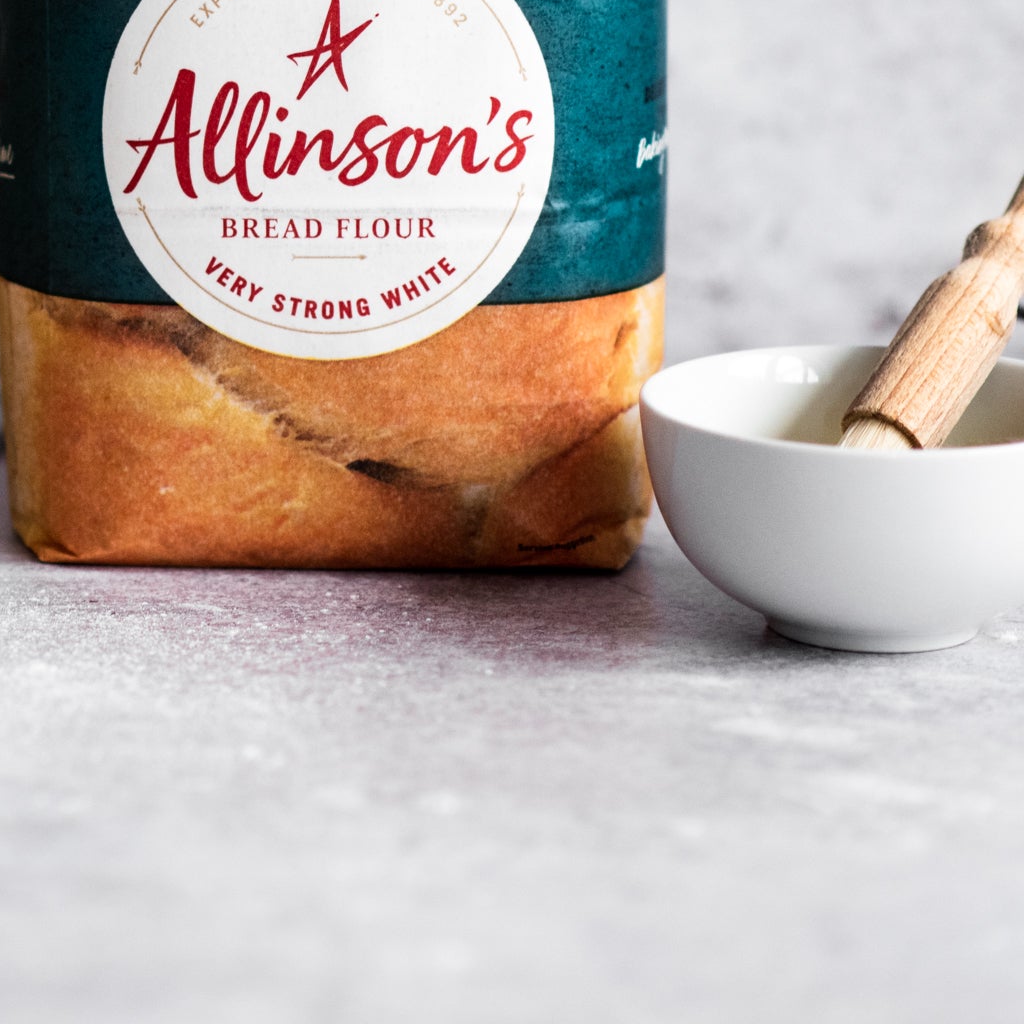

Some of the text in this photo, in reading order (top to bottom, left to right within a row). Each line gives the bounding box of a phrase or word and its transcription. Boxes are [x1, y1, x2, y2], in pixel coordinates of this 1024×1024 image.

[123, 67, 535, 203] Allinson's
[221, 217, 437, 240] BREAD FLOUR
[204, 256, 458, 320] VERY STRONG WHITE
